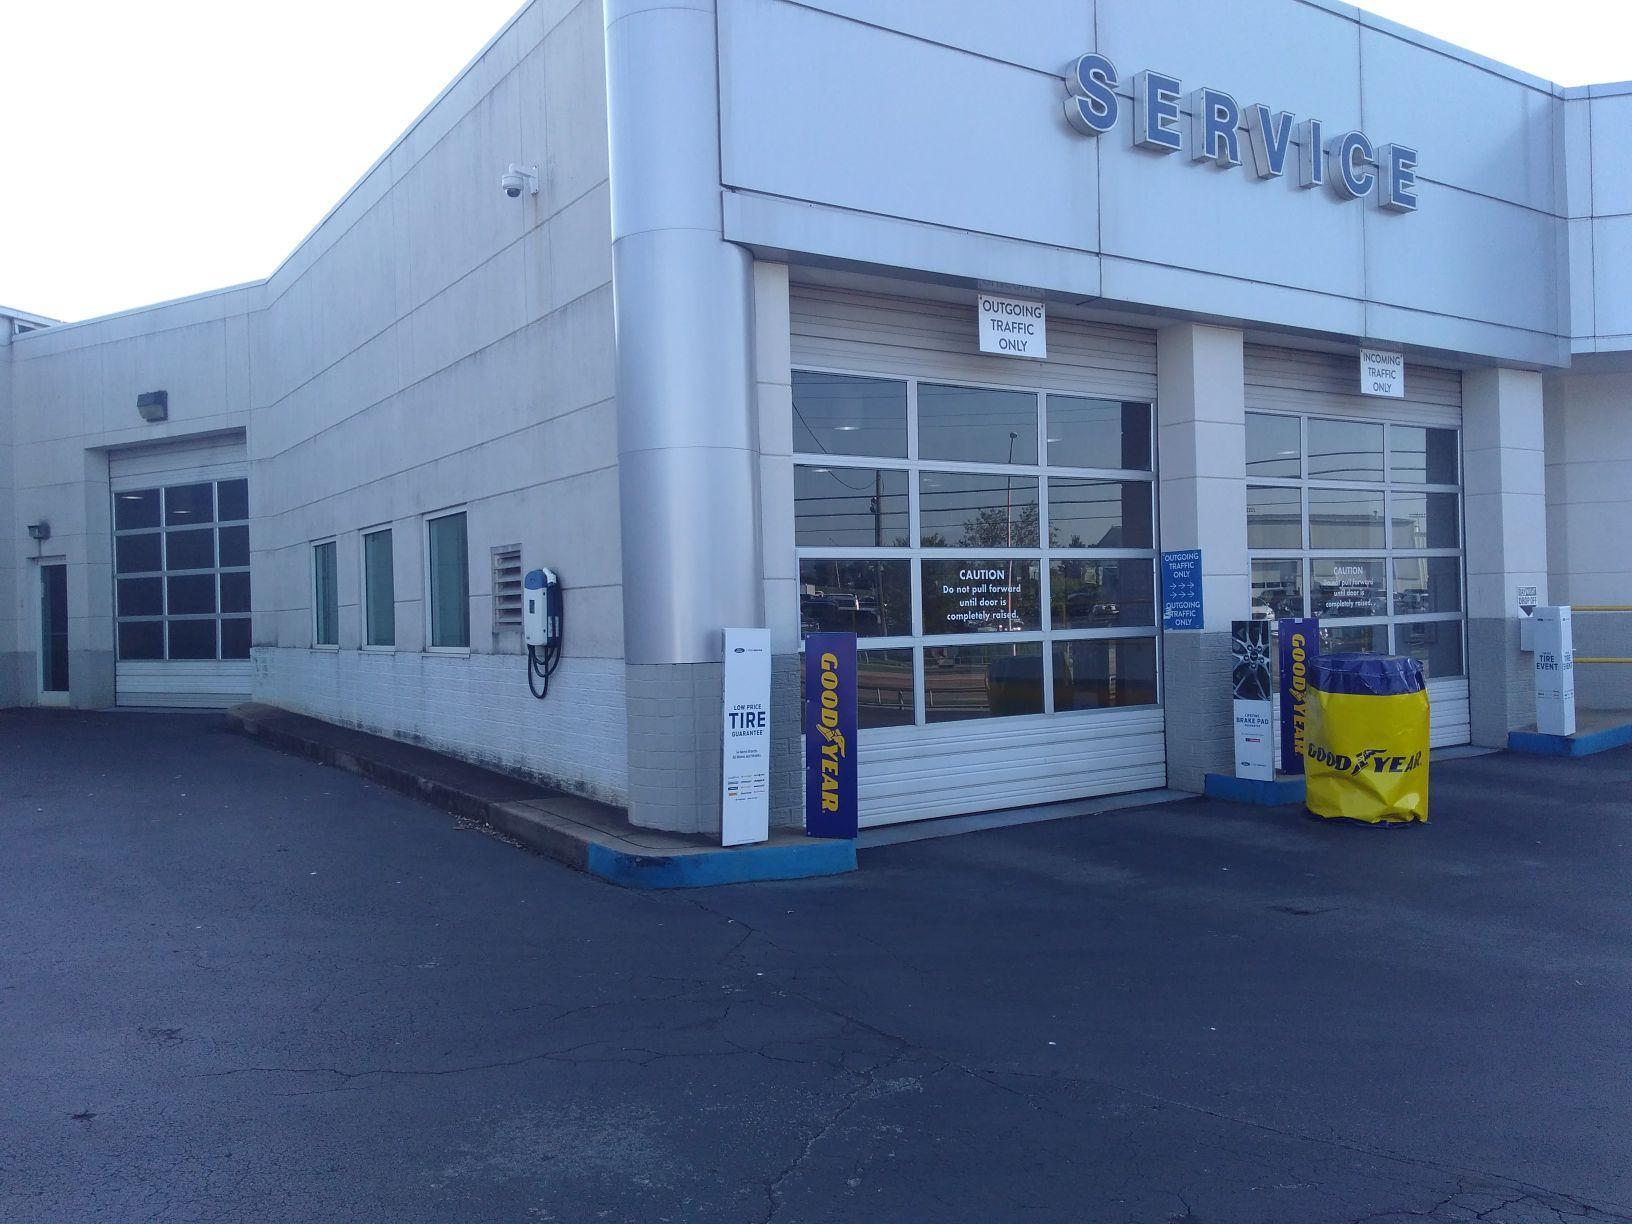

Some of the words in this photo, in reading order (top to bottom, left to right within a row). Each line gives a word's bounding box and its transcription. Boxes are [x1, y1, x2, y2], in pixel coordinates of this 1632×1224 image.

[1063, 52, 1418, 214] SERVICE
[983, 300, 1042, 318] OUTGOING
[990, 319, 1034, 335] TRAFFIC
[999, 338, 1027, 352] ONLY
[1363, 352, 1401, 366] INCOMING
[1368, 367, 1396, 379] TRAFFIC
[1373, 382, 1392, 392] ONLY
[1164, 553, 1199, 562] OUTGOING
[1169, 562, 1195, 570] TRAFFIC
[1333, 566, 1363, 575] CAUTION
[959, 569, 1005, 580] CAUTION
[943, 585, 954, 593] Do
[956, 585, 970, 593] not
[972, 584, 987, 595] pull
[989, 584, 1021, 593] forward
[959, 597, 977, 607] until
[979, 597, 999, 606] door
[1000, 597, 1007, 606] is
[1166, 601, 1200, 609] OUTGOING
[946, 610, 991, 622] completely
[992, 609, 1019, 619] raised.
[1170, 610, 1196, 618] TRAFFIC
[1175, 618, 1192, 626] ONLY
[1539, 655, 1555, 663] TIRE
[1536, 662, 1559, 671] EVENT
[728, 711, 766, 729] TIRE
